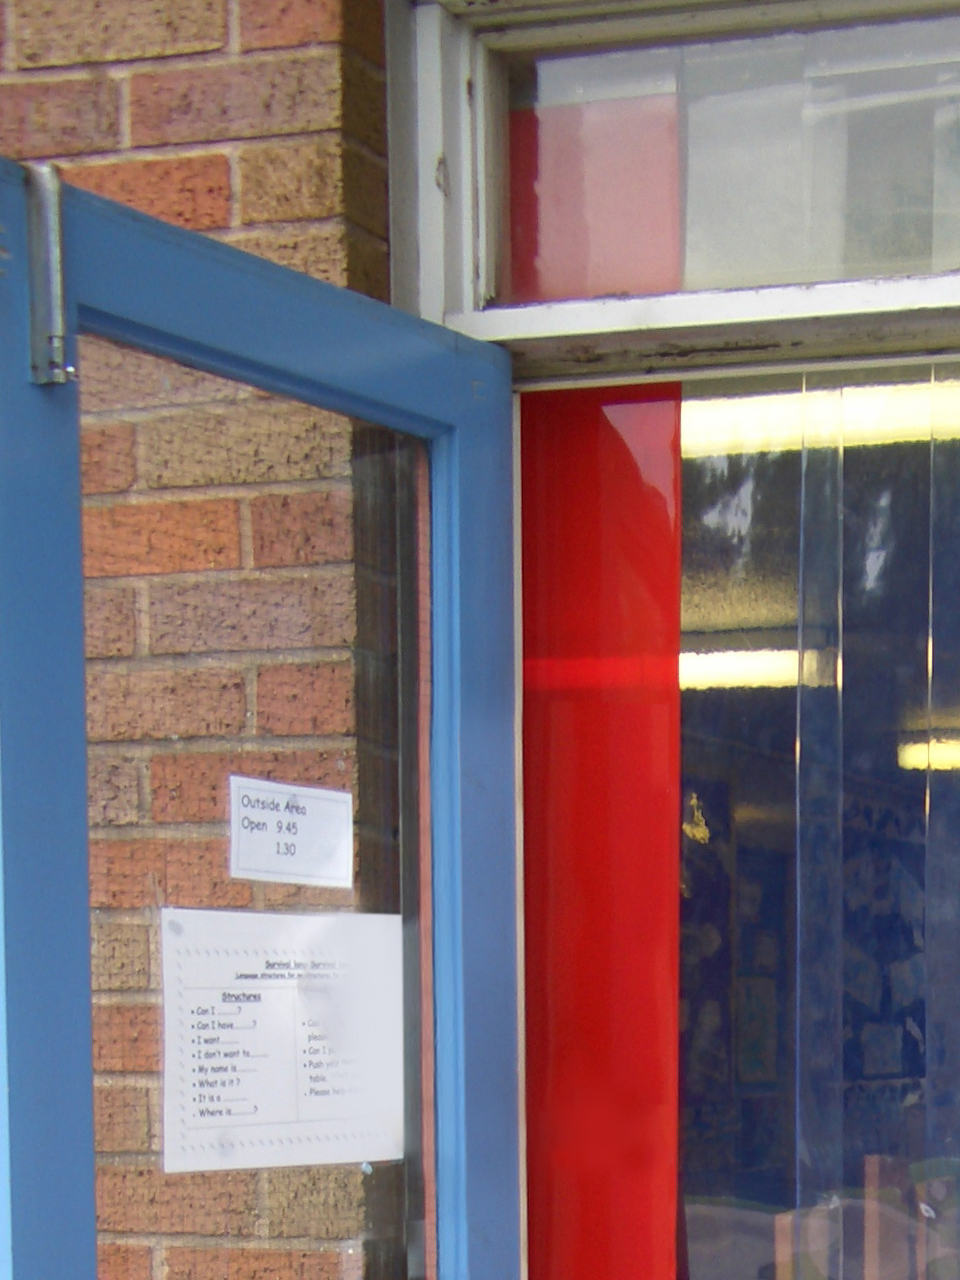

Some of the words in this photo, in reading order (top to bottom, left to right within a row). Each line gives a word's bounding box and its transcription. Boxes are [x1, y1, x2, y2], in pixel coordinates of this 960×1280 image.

[241, 794, 280, 812] Outside
[284, 801, 307, 816] Area
[241, 816, 268, 833] Open
[276, 819, 298, 836] 9.45
